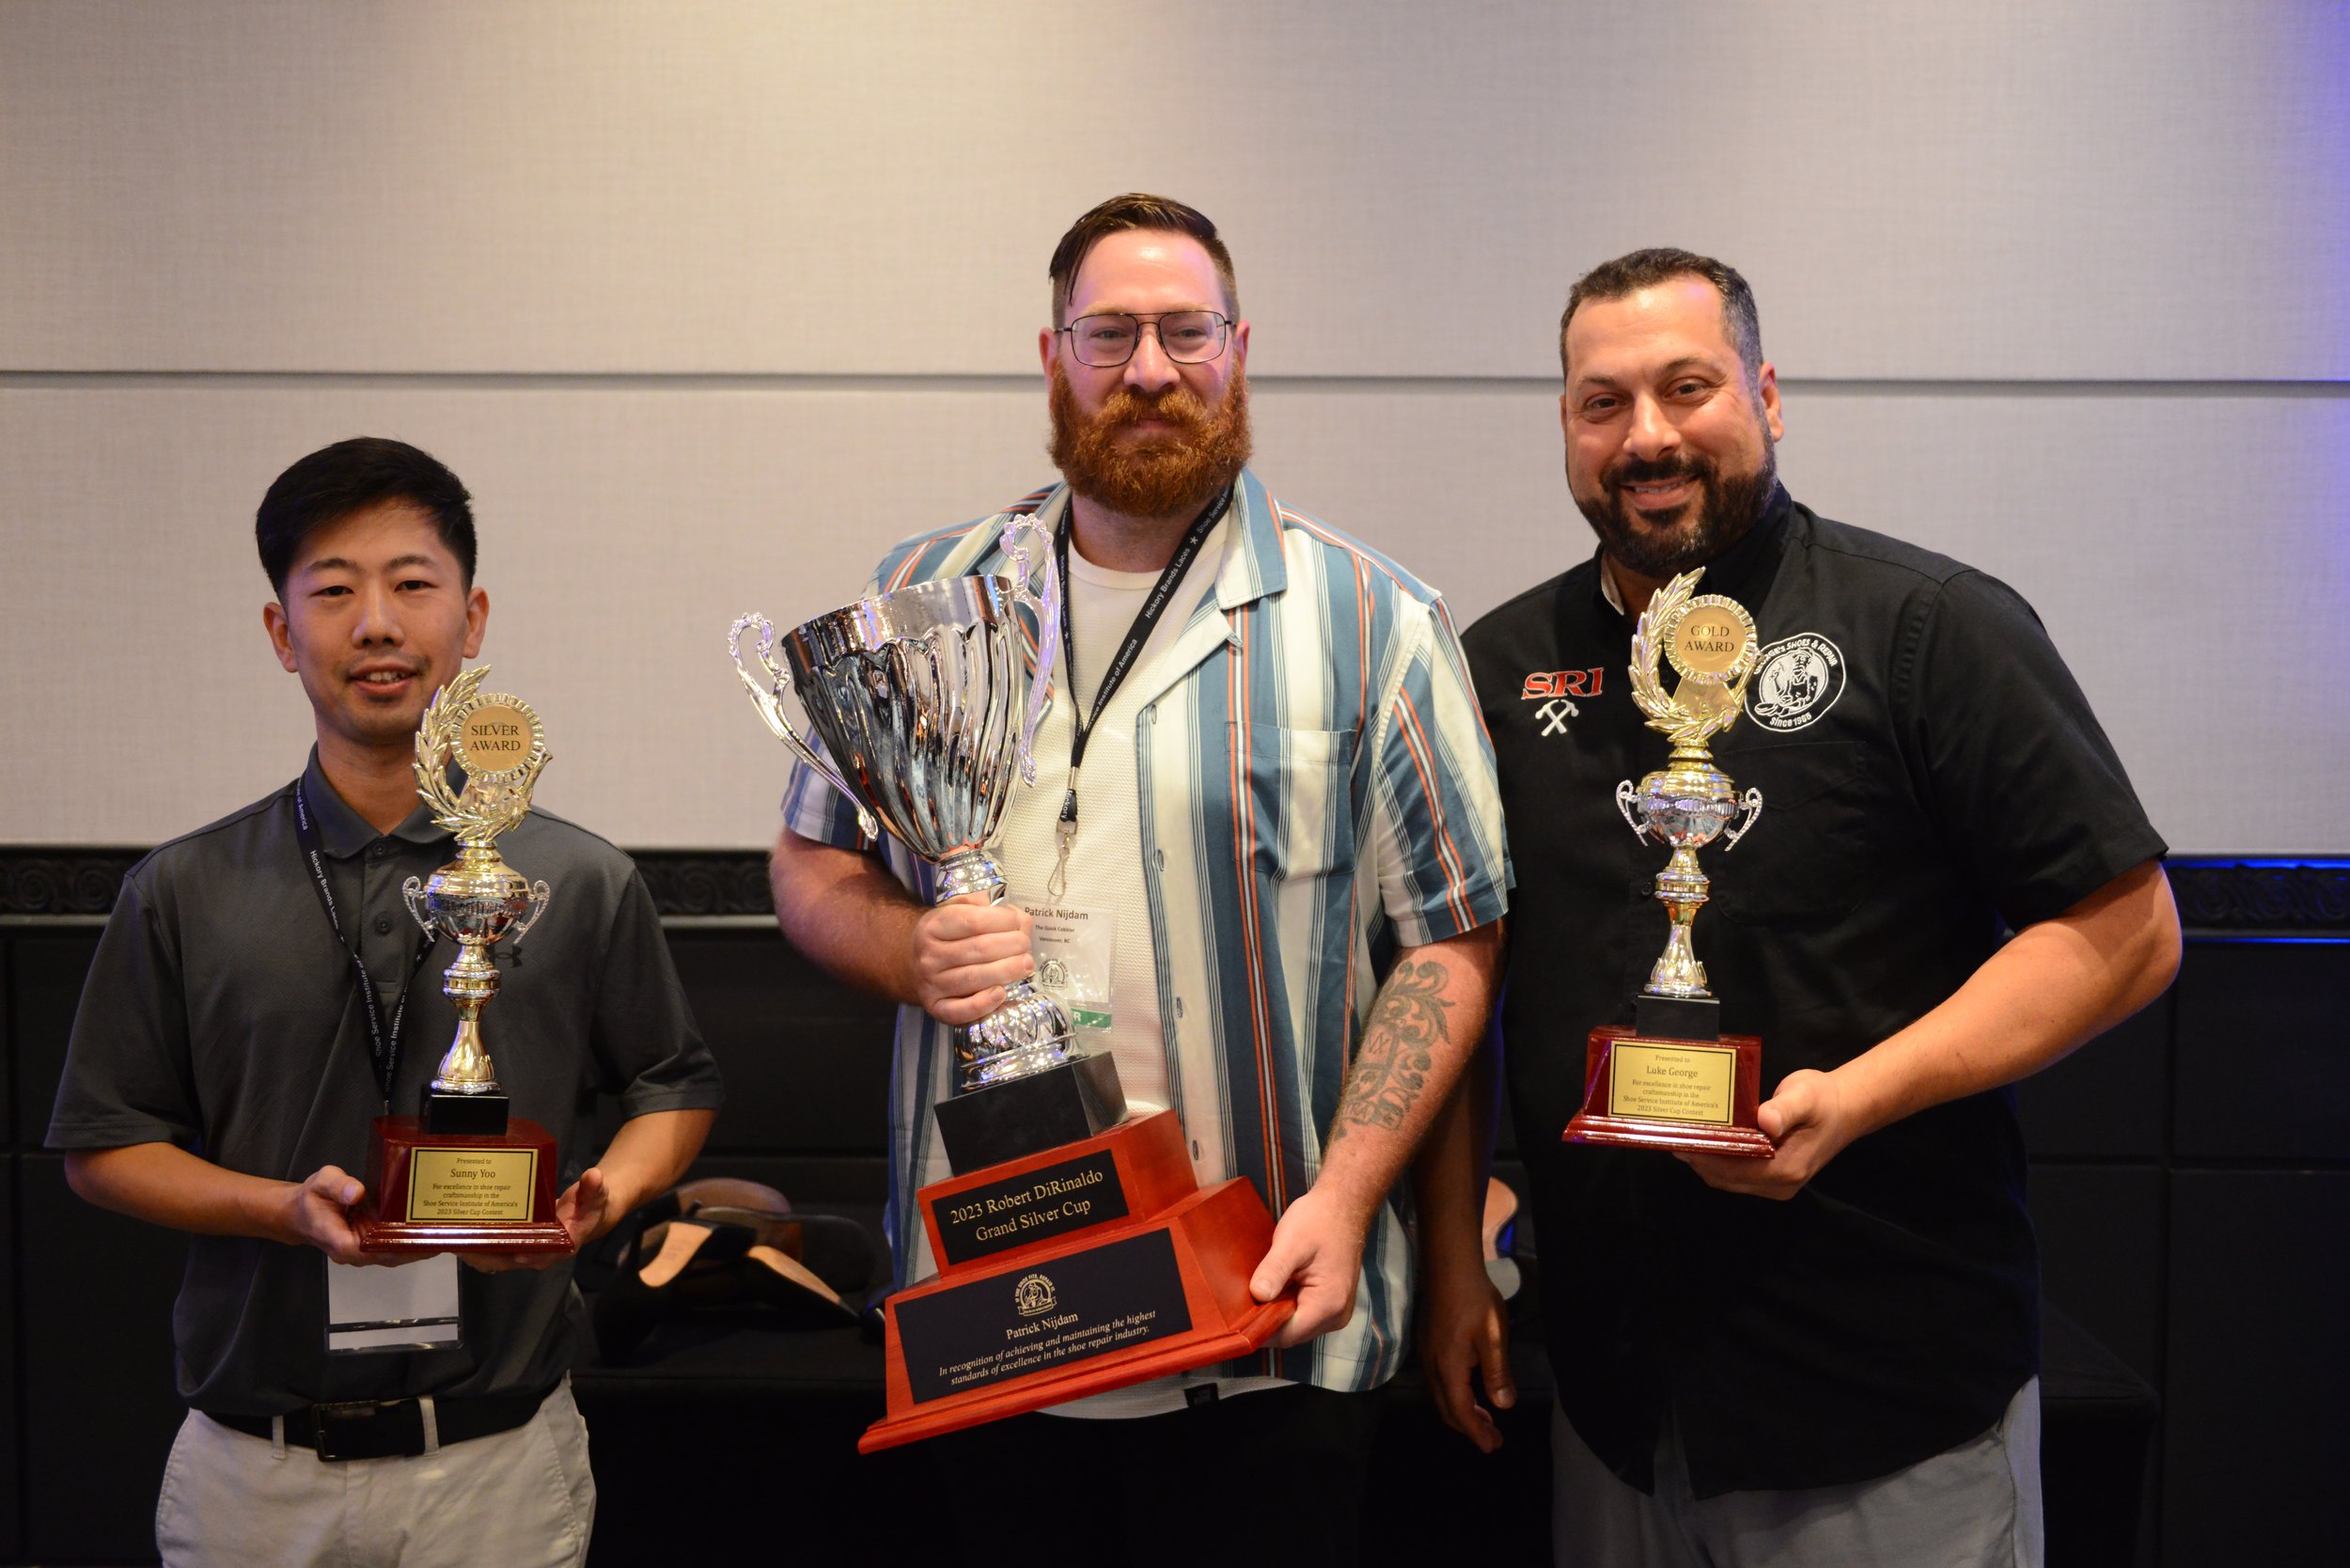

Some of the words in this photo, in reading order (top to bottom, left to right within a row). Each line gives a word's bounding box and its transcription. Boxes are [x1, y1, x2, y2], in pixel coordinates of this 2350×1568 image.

[1145, 591, 1165, 619] Hickory
[1160, 568, 1179, 592] Brands
[1175, 548, 1190, 568] Laces
[1691, 625, 1730, 636] GOLD
[1684, 640, 1734, 651] AWARD
[1786, 638, 1811, 650] SHOES
[1810, 639, 1819, 650] &
[1817, 643, 1838, 666] REPAIR
[1098, 676, 1117, 706] Institute
[1115, 666, 1121, 677] of
[1119, 639, 1137, 668] America
[1521, 667, 1604, 699] SRI
[471, 725, 519, 736] SILVER
[470, 740, 521, 750] AWARD
[310, 850, 324, 878] Hickory
[321, 878, 333, 906] Brands
[1025, 907, 1054, 917] Patrick
[1056, 910, 1089, 920] Nijdam
[361, 969, 372, 1003] Institute
[368, 1004, 379, 1035] Service
[391, 1004, 404, 1039] Institute
[1642, 1079, 1671, 1088] excellence
[1647, 1065, 1667, 1075] Luke
[1668, 1067, 1699, 1079] George
[1642, 1090, 1683, 1098] craftsmanship
[1690, 1100, 1718, 1108] America's
[1682, 1107, 1703, 1116] Contest
[450, 1168, 478, 1180] Sunny
[480, 1168, 496, 1178] Yoo
[949, 1202, 983, 1224] 2023
[986, 1190, 1033, 1214] Robert
[1033, 1169, 1104, 1200] DiRinaldo
[976, 1218, 1018, 1241] Grand
[1020, 1208, 1059, 1229] Silver
[1062, 1200, 1091, 1215] Cup
[1006, 1322, 1041, 1340] Patrick
[1042, 1312, 1079, 1330] Nijdam
[939, 1367, 948, 1376] In
[949, 1356, 994, 1372] recognition
[995, 1350, 1005, 1362] of
[1005, 1341, 1044, 1358] achieving
[1045, 1334, 1060, 1347] and
[1062, 1323, 1110, 1342] maintaining
[1112, 1318, 1125, 1329] the
[1127, 1310, 1156, 1325] highest
[950, 1368, 989, 1386] standards
[991, 1362, 999, 1375] of
[1000, 1355, 1042, 1372] excellence
[1043, 1351, 1052, 1360] in
[1053, 1346, 1066, 1357] the
[1068, 1341, 1087, 1354] shoe
[1089, 1335, 1113, 1348] repair
[1115, 1325, 1150, 1341] industry.
